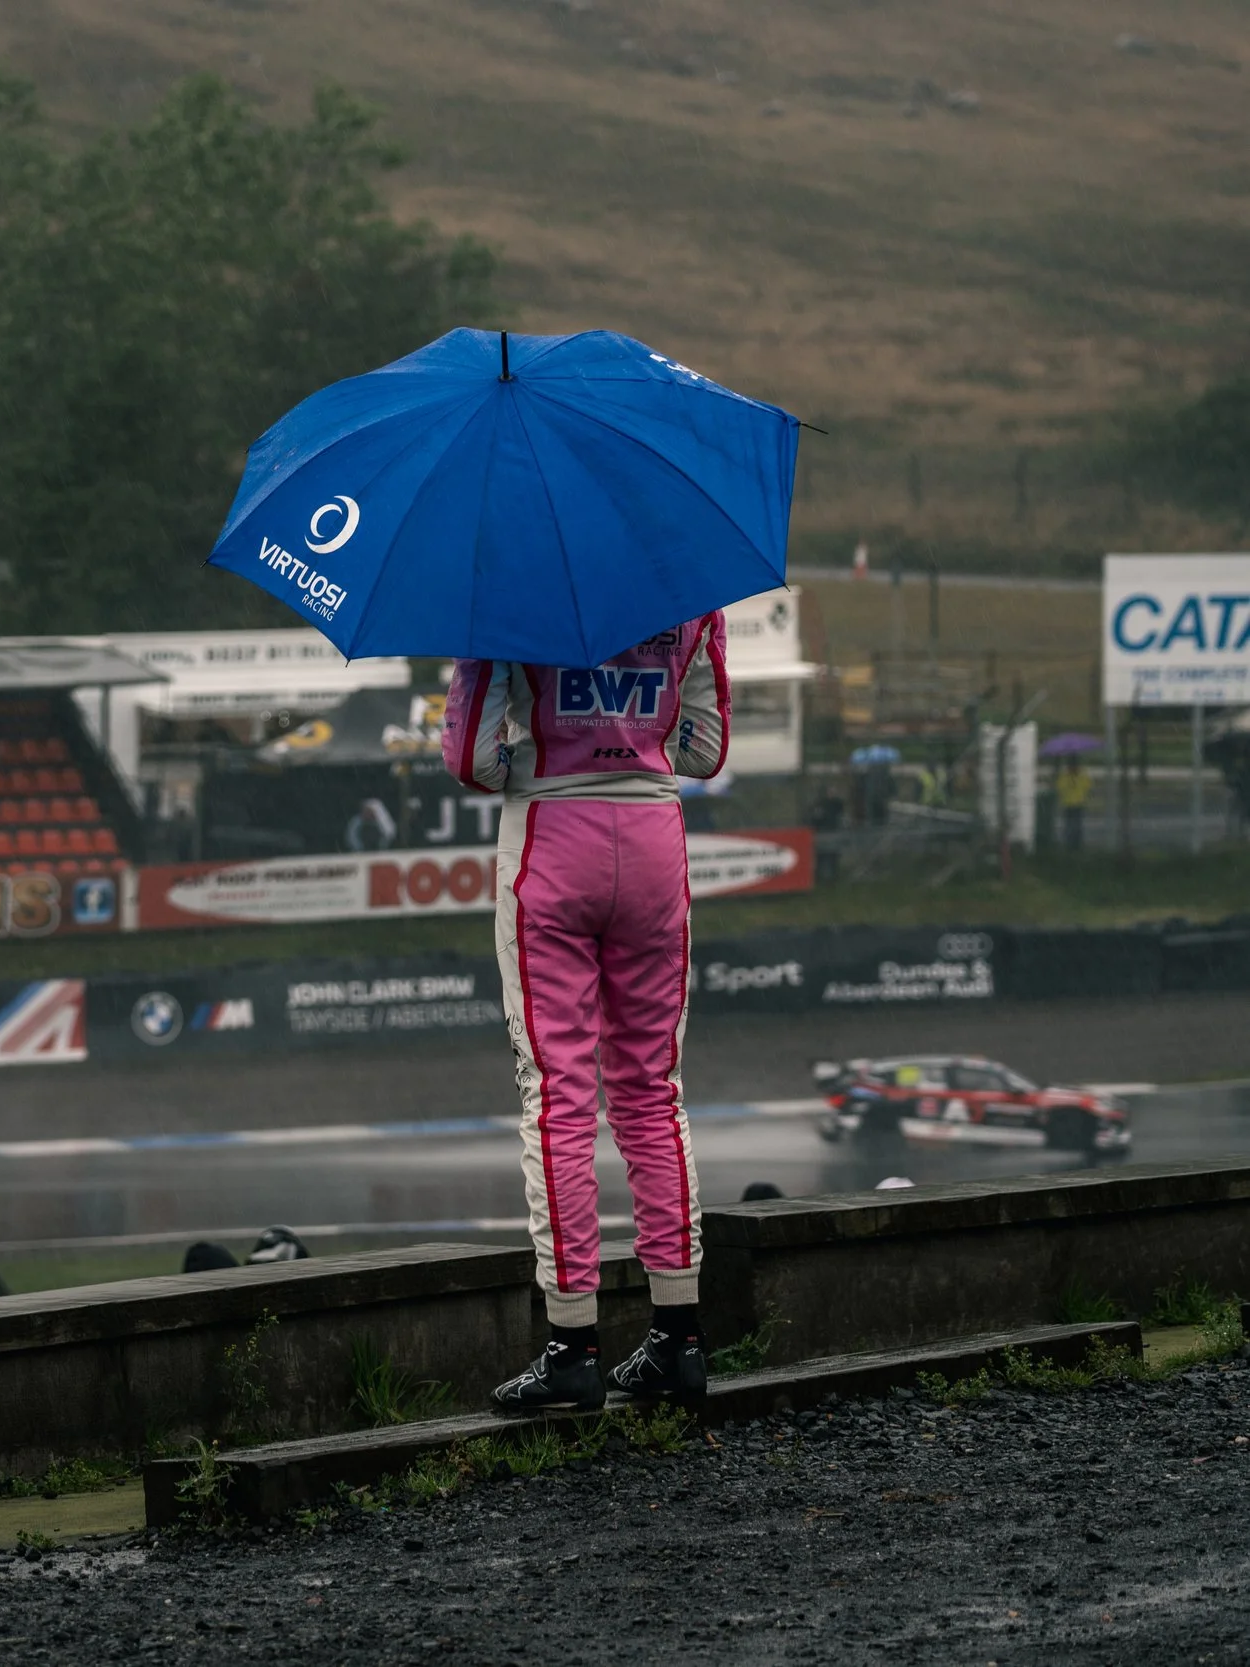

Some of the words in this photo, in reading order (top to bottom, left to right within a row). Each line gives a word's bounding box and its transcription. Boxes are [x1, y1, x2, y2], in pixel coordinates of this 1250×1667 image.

[258, 536, 348, 612] VIRTUOSI
[301, 594, 336, 622] RACING
[637, 646, 682, 657] RACING
[558, 668, 666, 717] BWT
[555, 718, 578, 727] BEST
[581, 719, 611, 728] WATER
[367, 857, 499, 909] ROO
[287, 980, 345, 1009] JOHN
[348, 976, 412, 1005] CLARK
[415, 973, 476, 999] BMW
[705, 961, 803, 996] Sport
[823, 981, 939, 1001] Aberdeen
[942, 978, 994, 998] Audi
